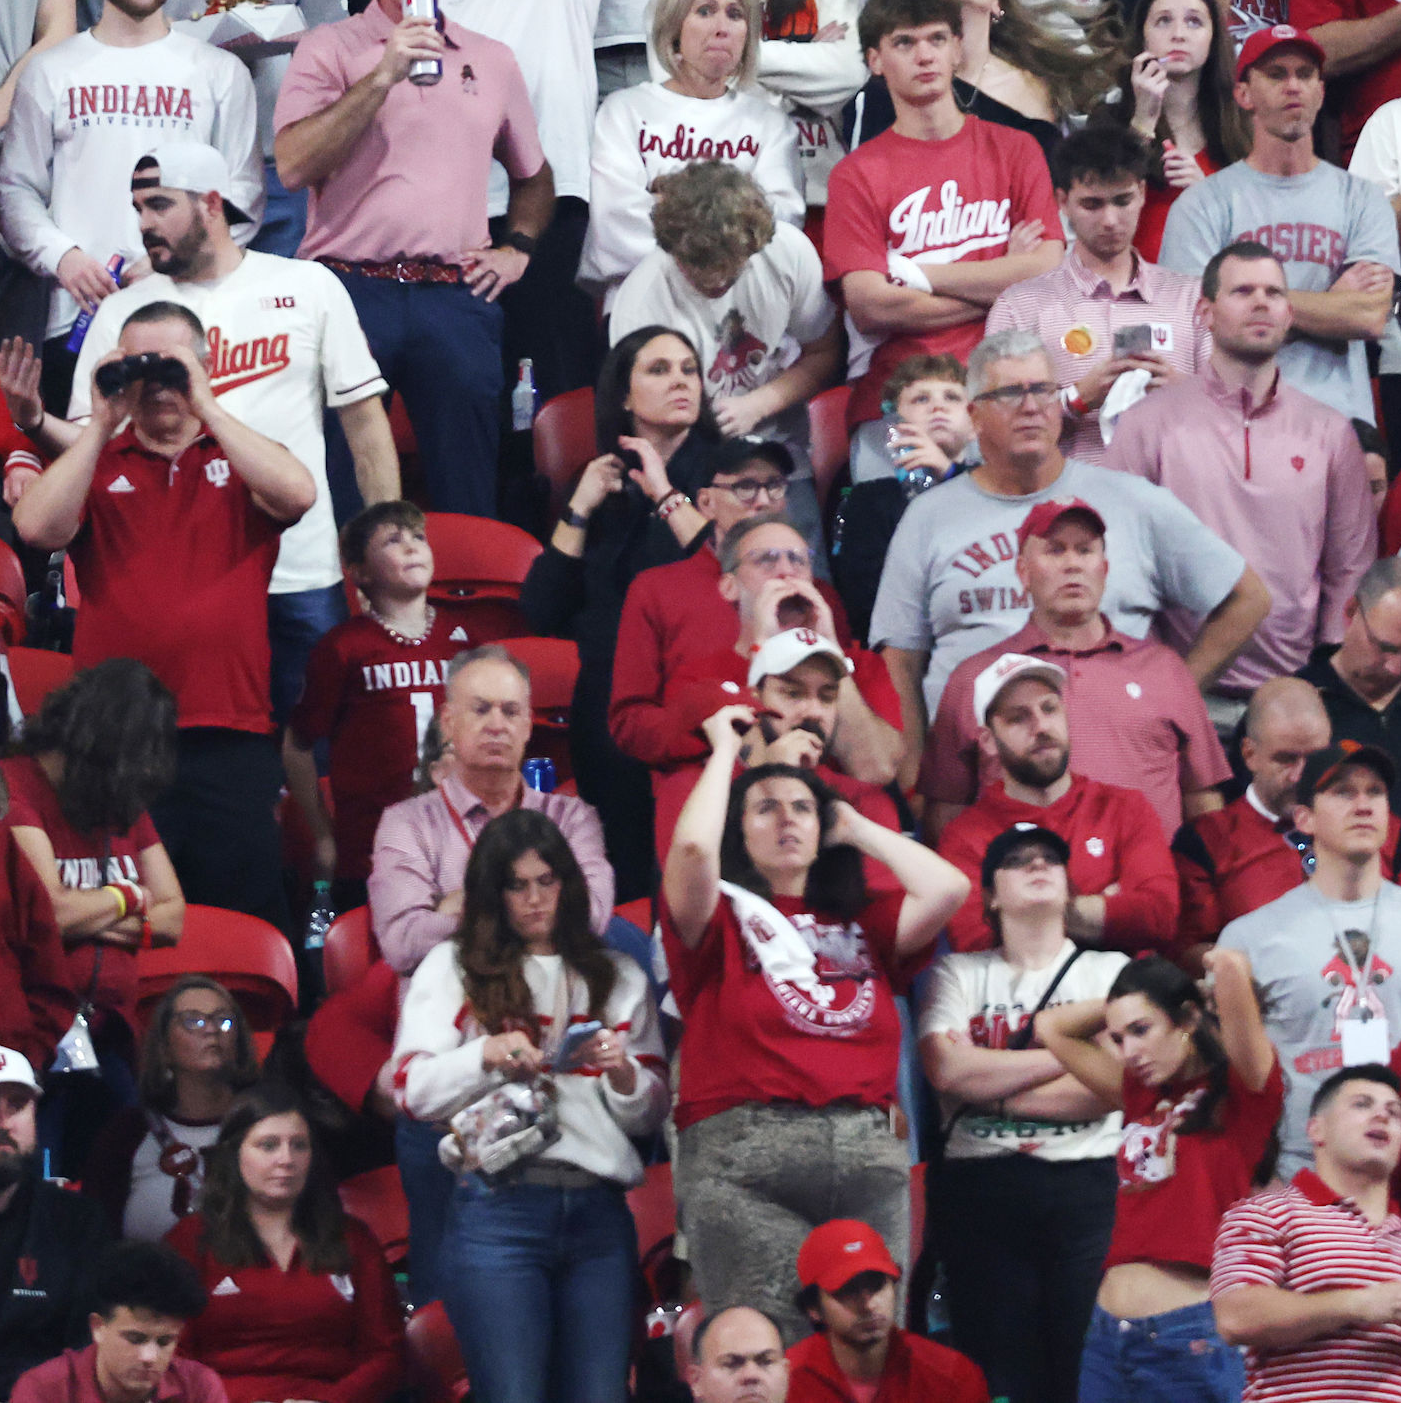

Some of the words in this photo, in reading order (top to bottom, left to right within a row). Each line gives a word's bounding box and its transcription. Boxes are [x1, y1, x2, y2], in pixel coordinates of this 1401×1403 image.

[68, 85, 194, 121] INDIANA
[69, 117, 193, 132] UNIVERSITY
[638, 120, 760, 164] indiana
[206, 326, 290, 380] diana
[362, 660, 449, 691] INDIA
